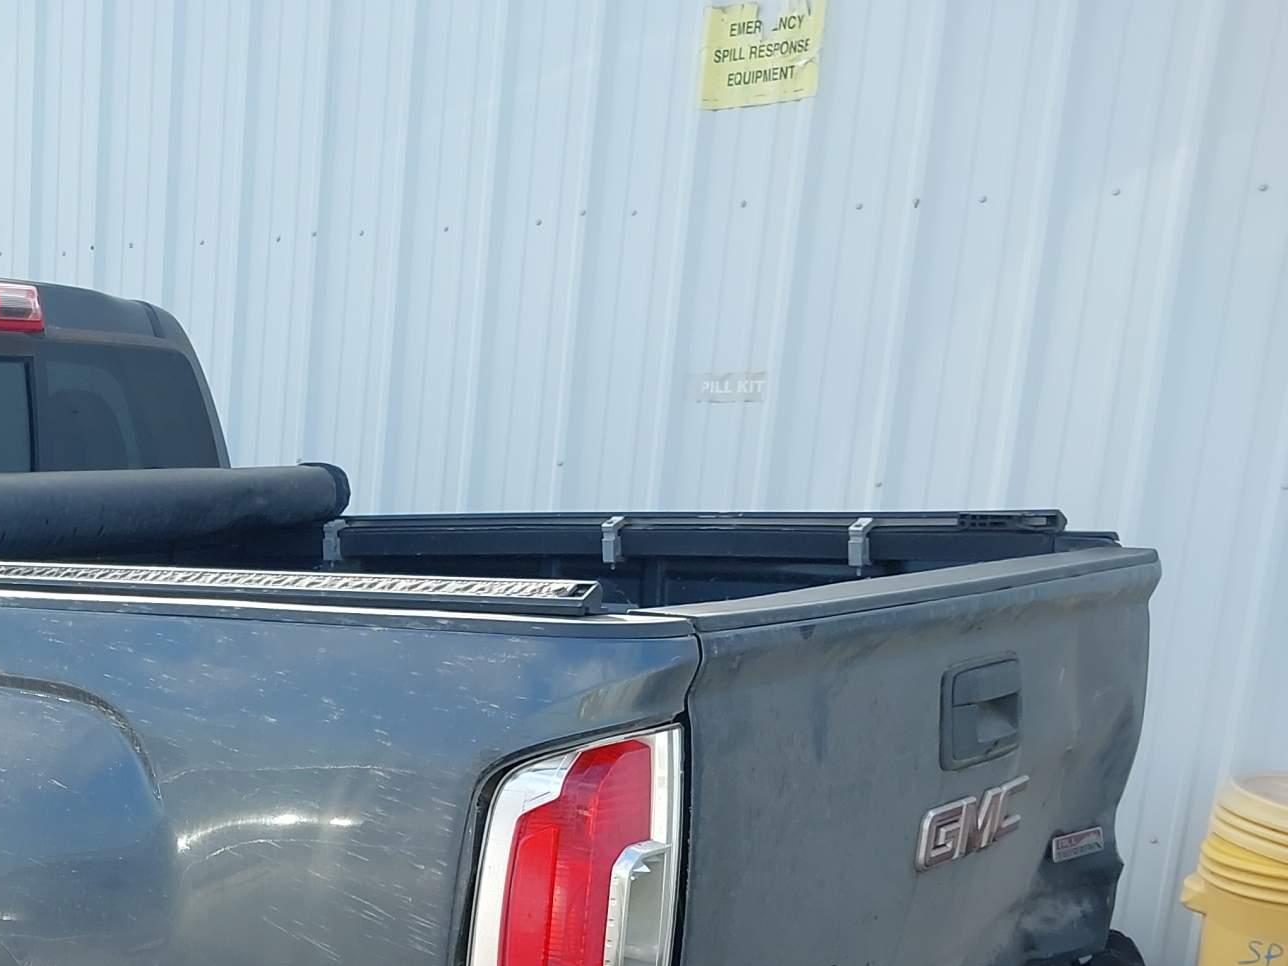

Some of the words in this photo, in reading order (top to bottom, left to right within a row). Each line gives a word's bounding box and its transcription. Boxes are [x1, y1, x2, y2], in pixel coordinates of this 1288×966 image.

[729, 15, 805, 37] EMERNCY
[713, 47, 746, 64] SPILL
[749, 38, 811, 60] RESPONSE
[727, 65, 796, 87] EQUIPMENT
[702, 380, 733, 393] PILL
[737, 380, 767, 393] KIT
[915, 775, 1030, 873] GMC
